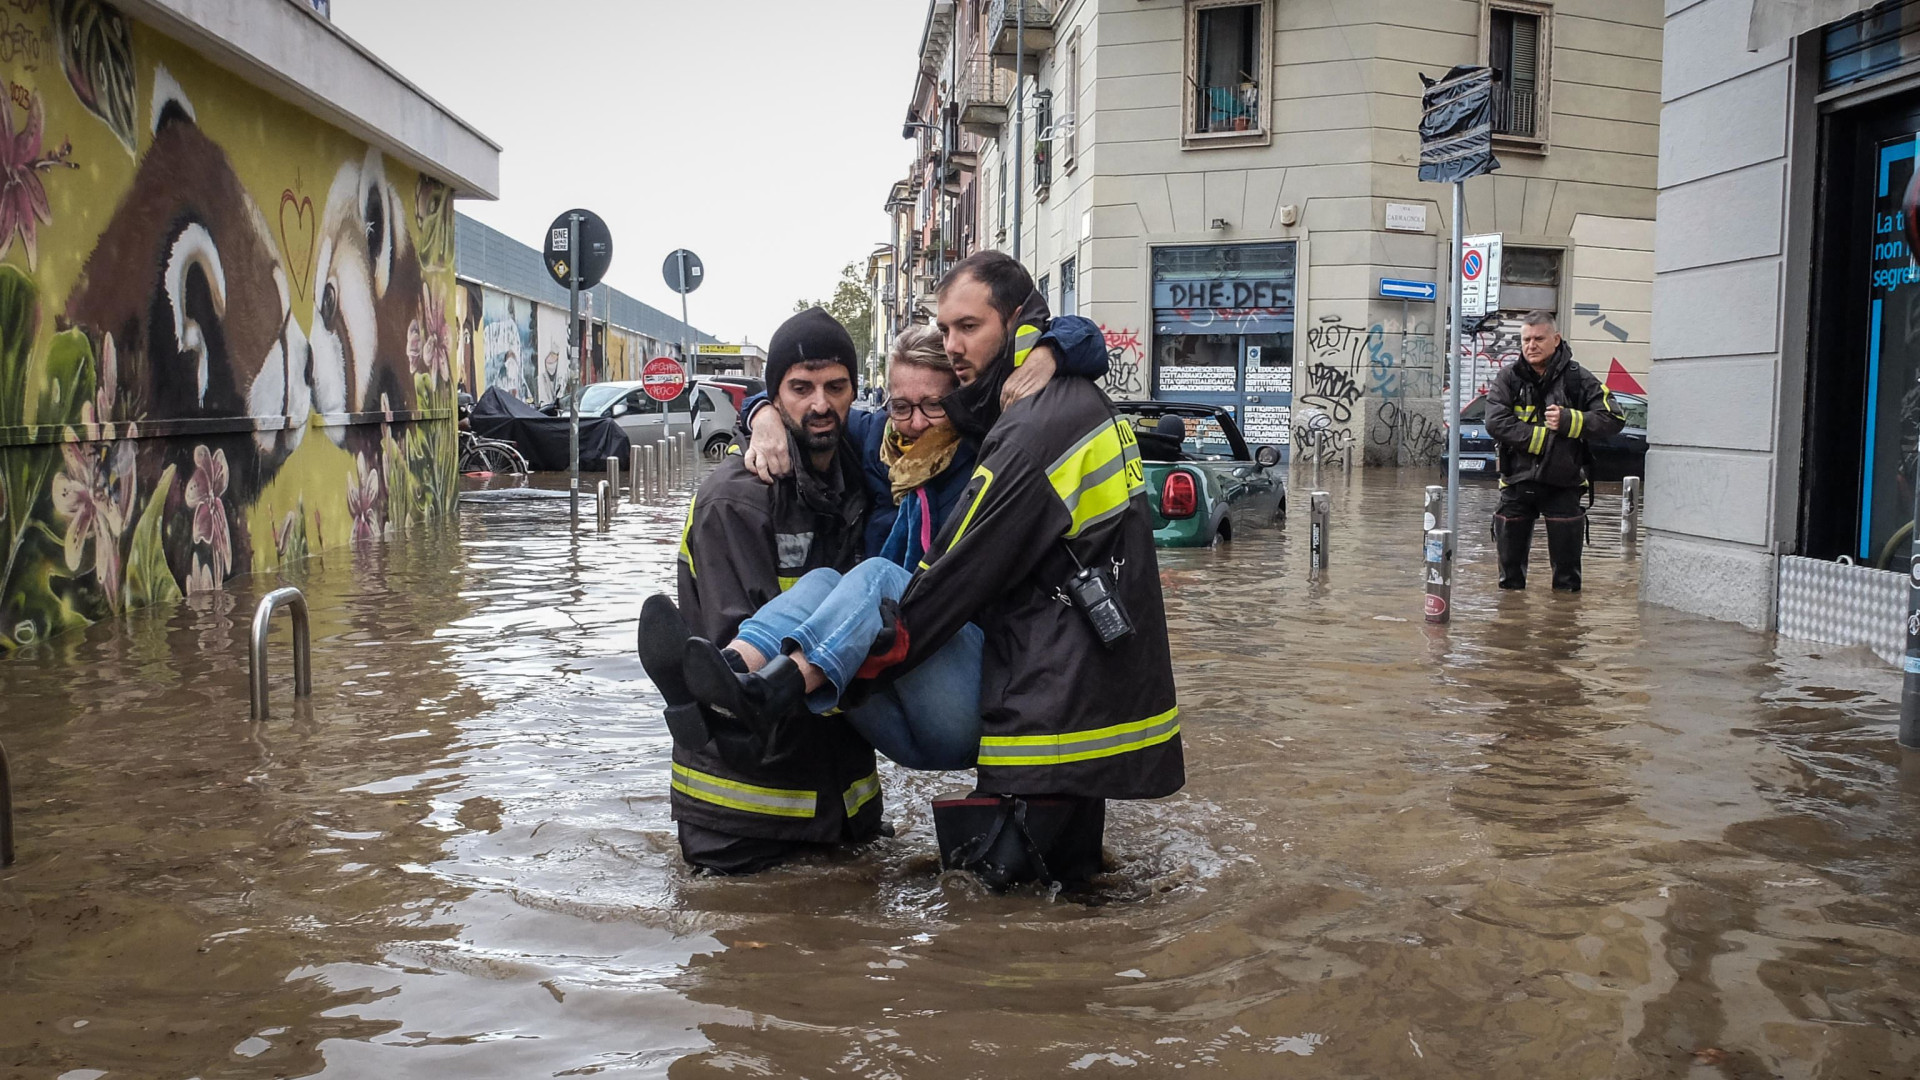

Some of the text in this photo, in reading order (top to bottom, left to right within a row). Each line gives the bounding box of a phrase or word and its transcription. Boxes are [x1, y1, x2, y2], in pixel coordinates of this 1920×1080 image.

[1876, 210, 1904, 234] La t
[553, 229, 567, 240] BNE
[1875, 241, 1903, 260] non
